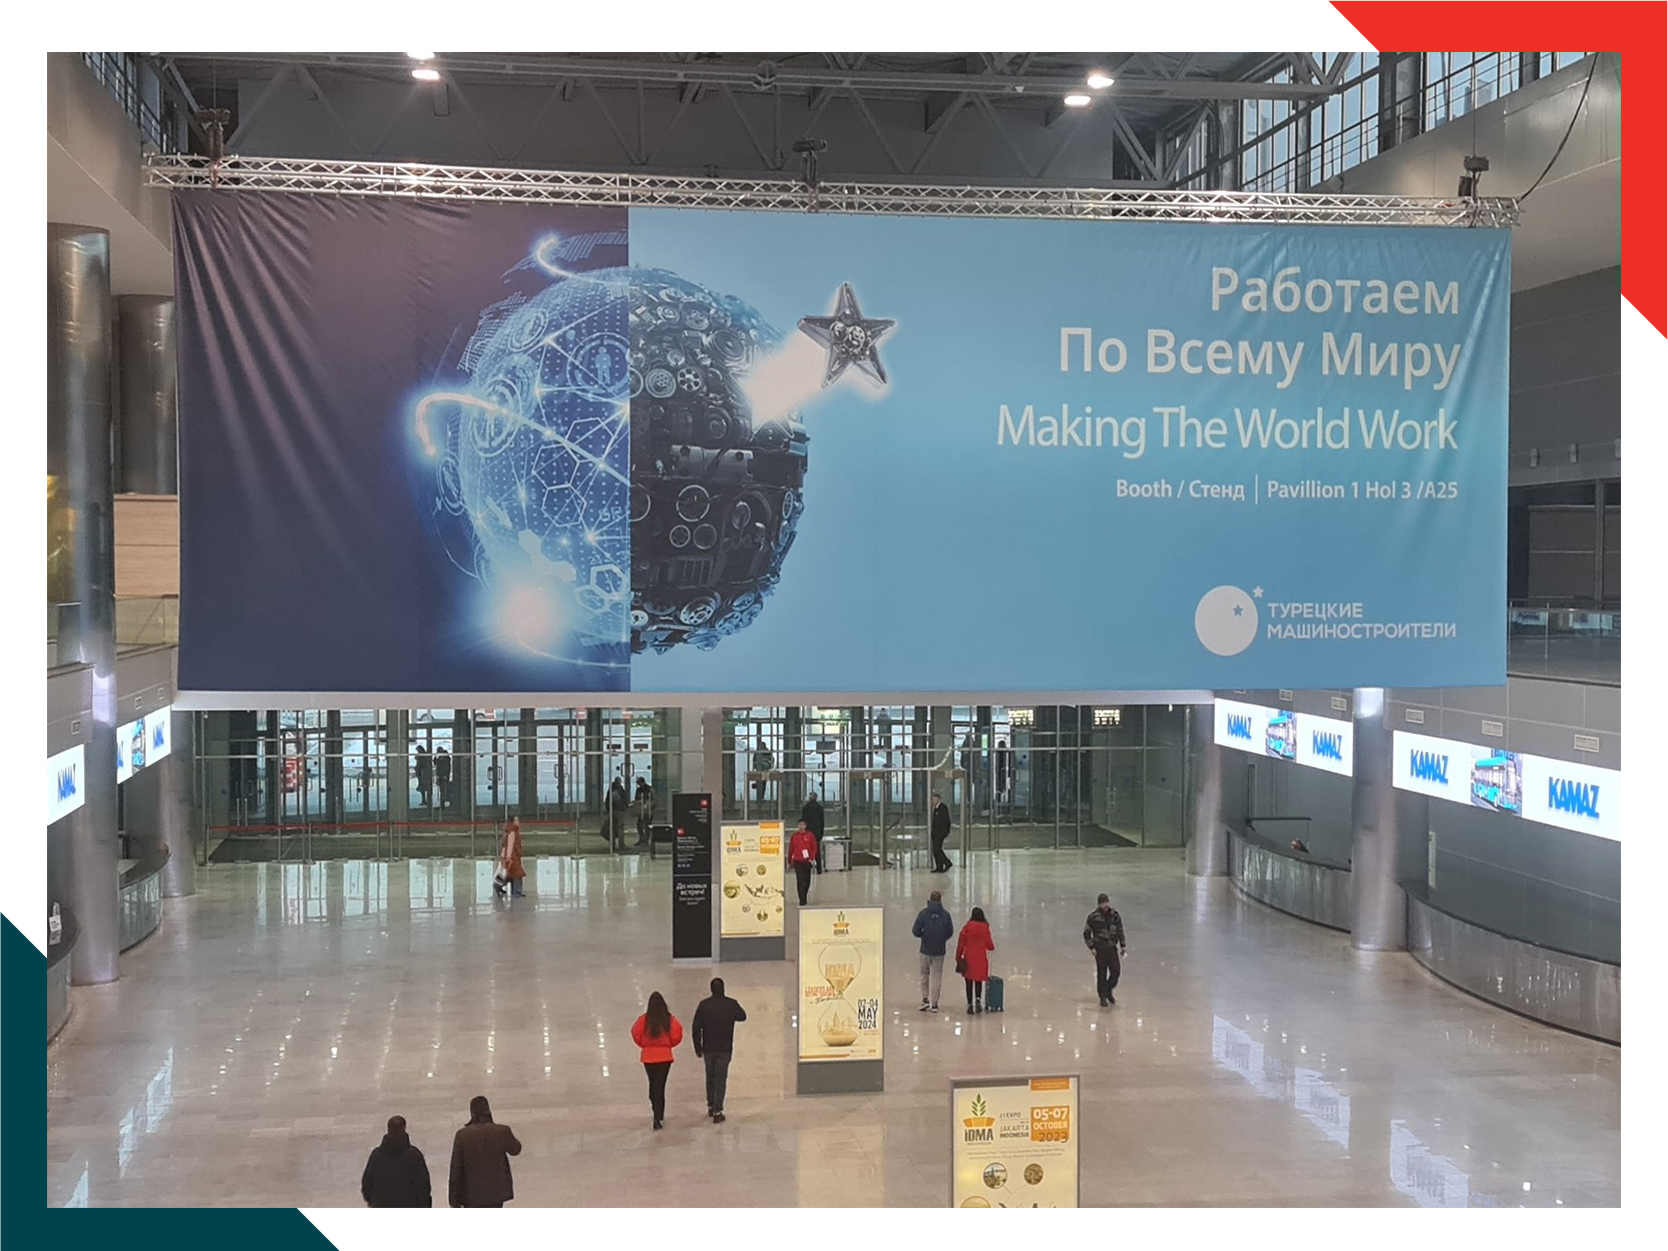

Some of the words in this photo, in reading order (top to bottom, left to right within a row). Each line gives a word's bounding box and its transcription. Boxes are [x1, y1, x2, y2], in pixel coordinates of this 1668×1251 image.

[1211, 265, 1460, 315] Работаем
[1060, 326, 1128, 373] По
[1147, 328, 1305, 389] Всему
[1321, 331, 1461, 391] Миру
[997, 403, 1147, 460] Making
[1152, 405, 1228, 450] The
[1234, 406, 1351, 451] World
[1357, 407, 1459, 451] Work
[1115, 478, 1174, 499] Booth
[1188, 479, 1246, 502] Стенд
[1266, 479, 1345, 500] Pavillion
[1351, 481, 1360, 500] 1
[1365, 480, 1397, 500] Hol
[1401, 481, 1412, 500] 3
[1415, 481, 1459, 501] /A25
[1267, 602, 1364, 621] ТУРЕЦКИЕ
[1266, 622, 1458, 640] МАШИНОСТРОИТЕЛИ
[1227, 712, 1252, 740] KAMAZ
[1312, 729, 1343, 761] KAMAZ
[1410, 748, 1449, 785] KAMAZ
[1548, 776, 1600, 819] KAMAZ
[858, 1007, 878, 1020] MAY
[858, 1020, 877, 1030] 2024
[1033, 1107, 1069, 1120] 05-07
[999, 1124, 1029, 1132] JAKARTA
[1032, 1120, 1068, 1130] OCTOBER
[1039, 1131, 1069, 1143] 2023
